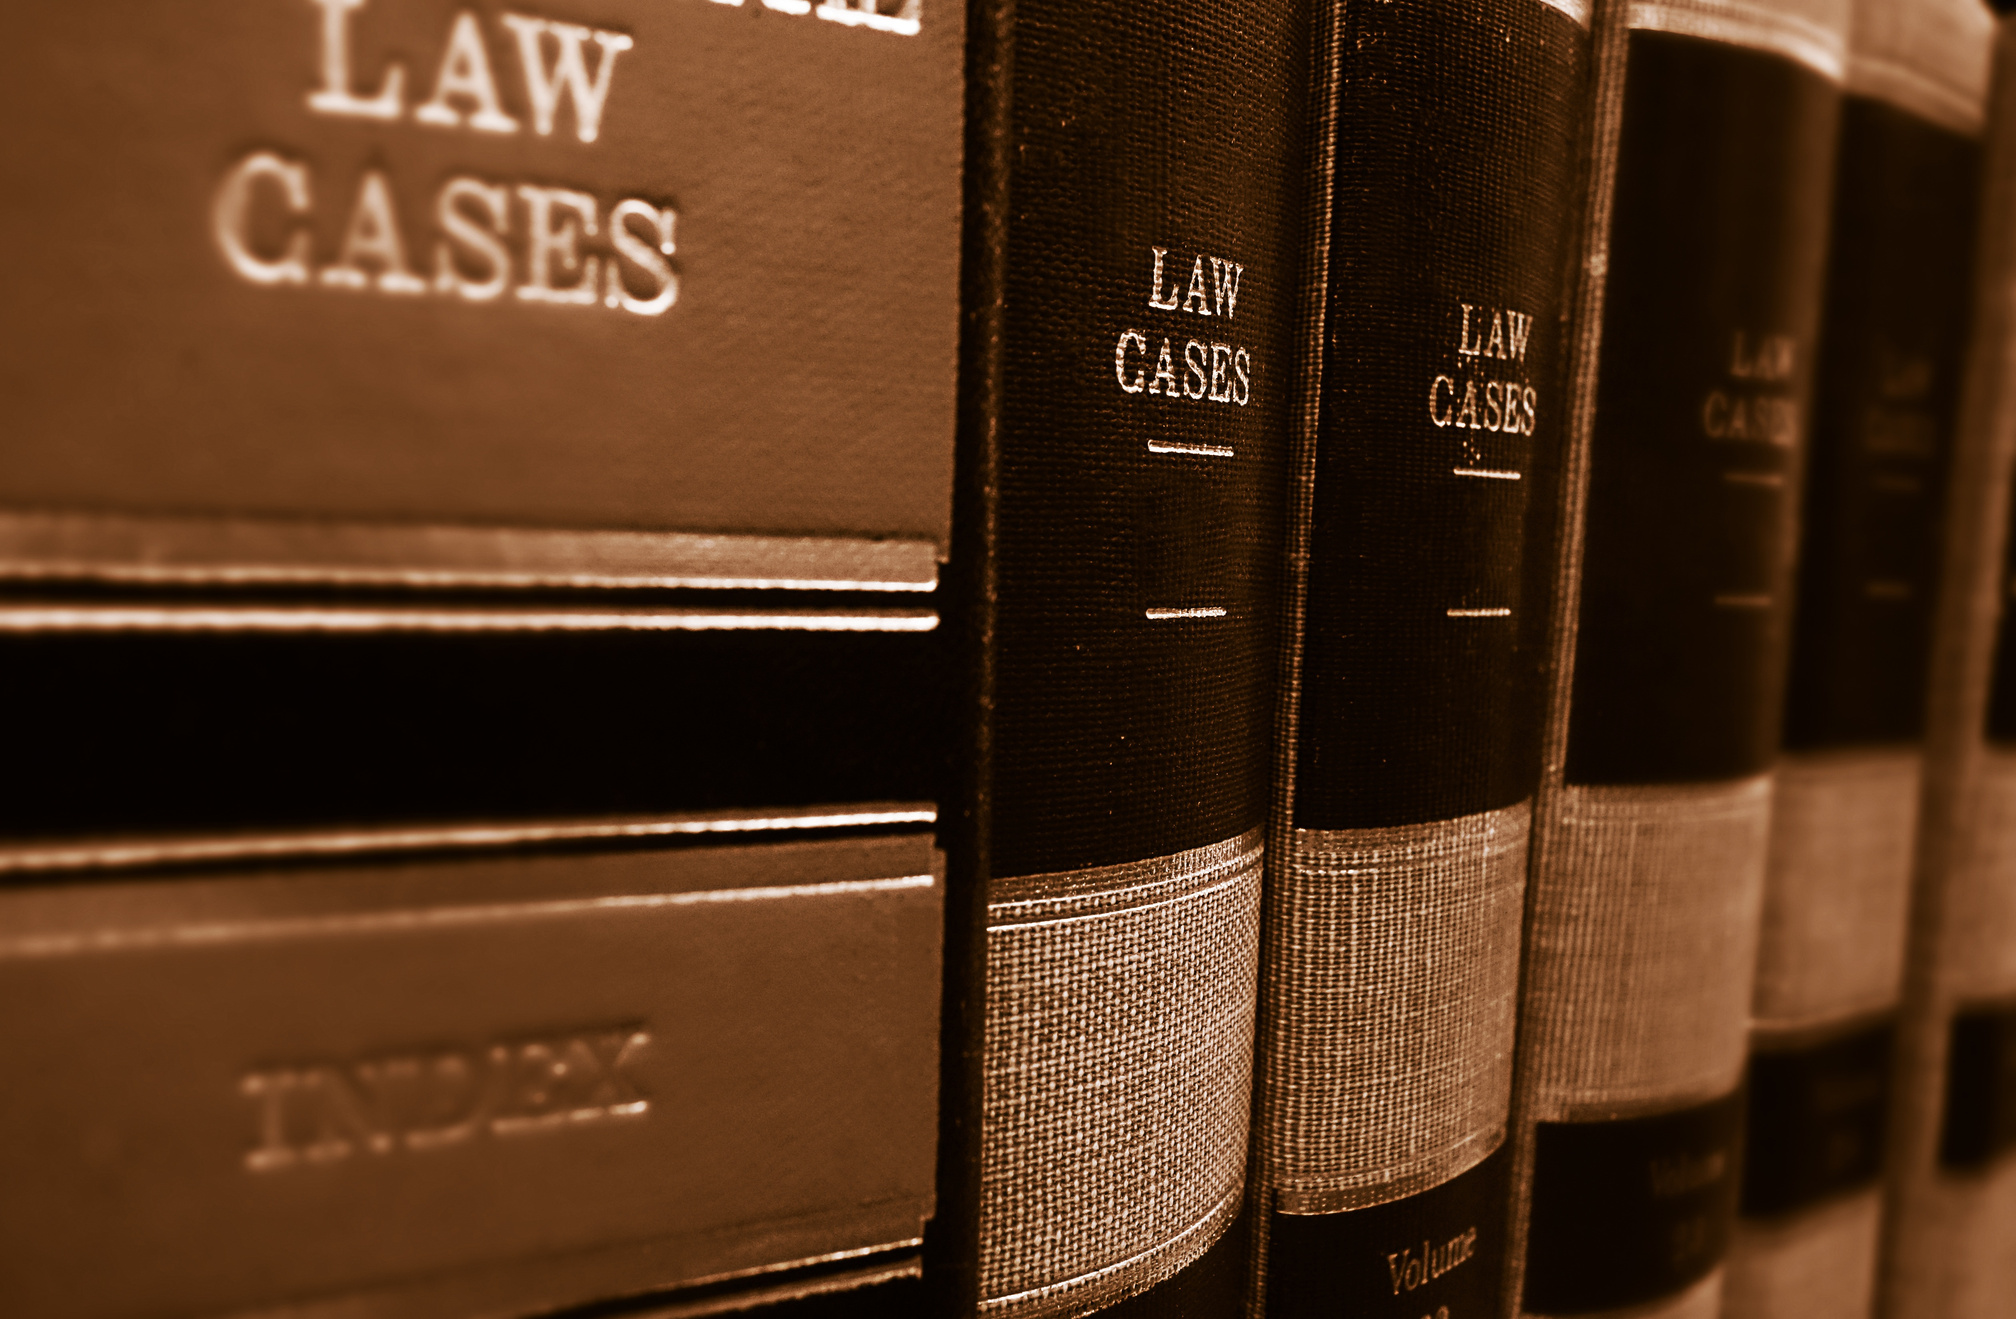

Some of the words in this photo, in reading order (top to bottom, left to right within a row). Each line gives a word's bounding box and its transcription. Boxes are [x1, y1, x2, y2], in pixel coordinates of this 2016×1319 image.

[306, 0, 634, 143] LAW
[212, 151, 680, 315] CASES
[1148, 246, 1244, 320] LAW
[1114, 328, 1251, 406] CASES
[1457, 303, 1534, 362] LAW
[1429, 374, 1537, 436] CASES
[240, 1030, 651, 1171] INDEX
[1386, 1226, 1478, 1296] Volume
